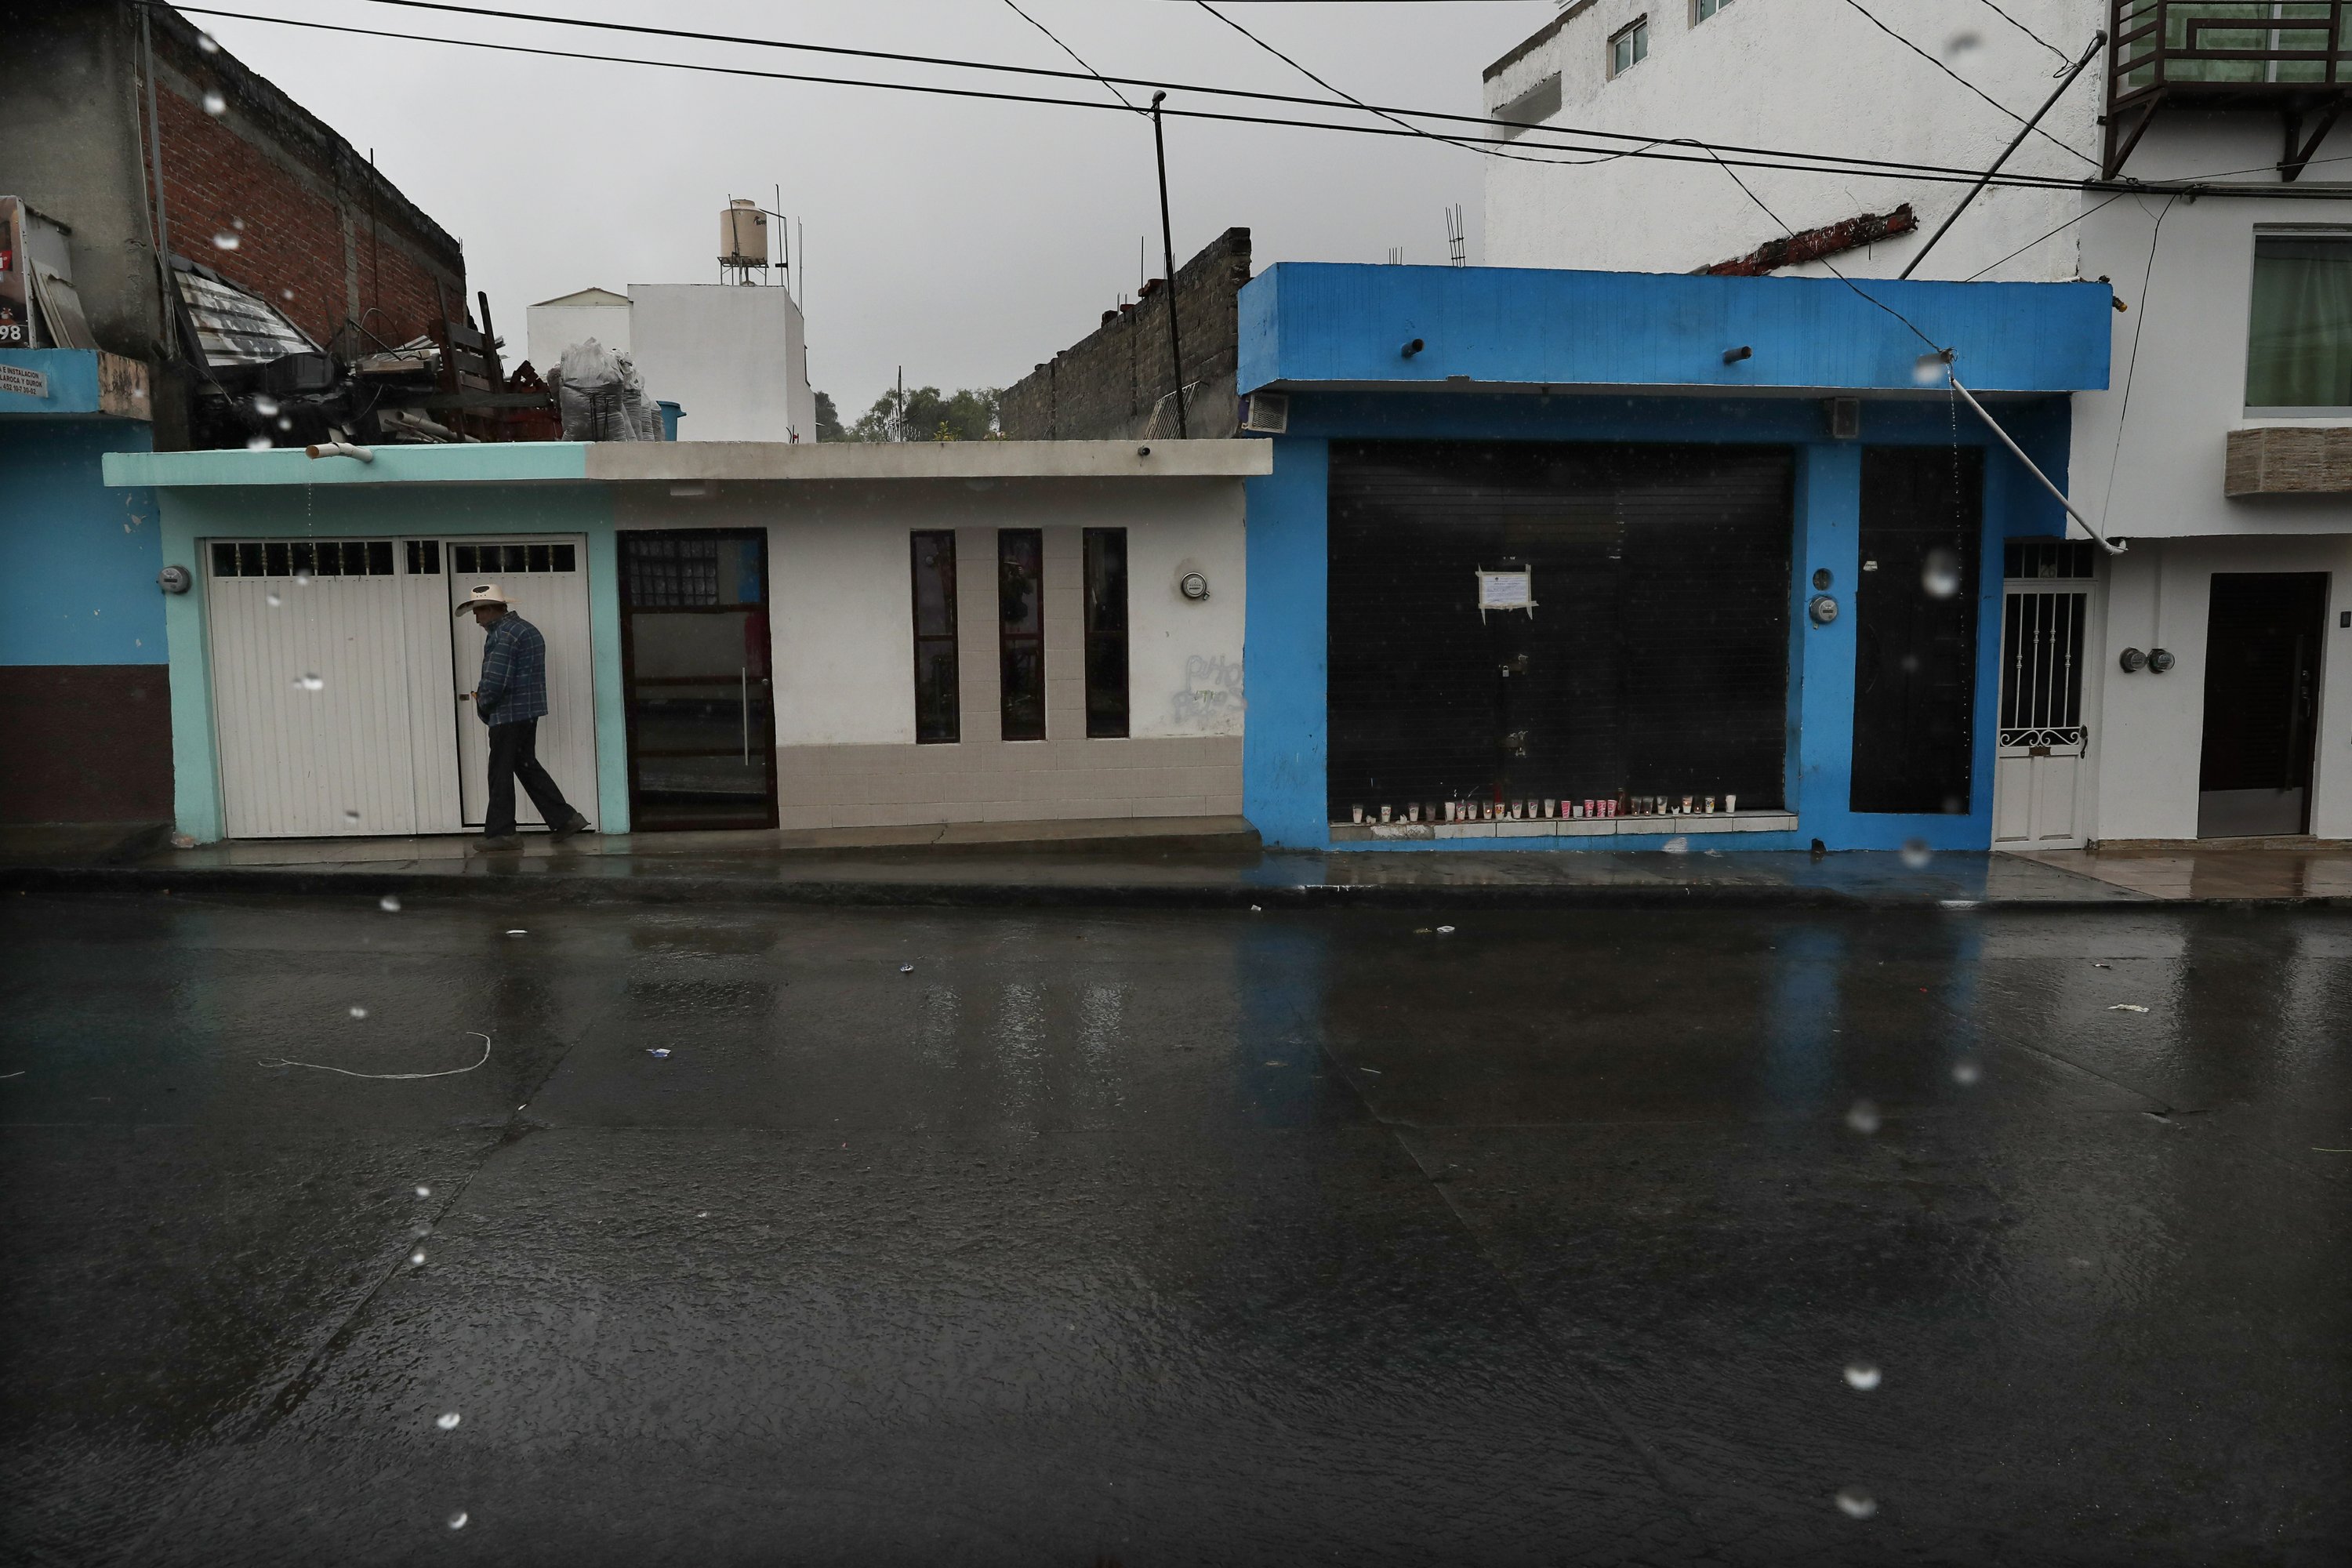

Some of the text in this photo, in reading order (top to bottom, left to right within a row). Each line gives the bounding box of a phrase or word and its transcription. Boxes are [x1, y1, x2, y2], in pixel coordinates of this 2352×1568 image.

[0, 325, 21, 340] 98
[7, 368, 39, 379] INSTALACION
[26, 379, 42, 387] DUROK
